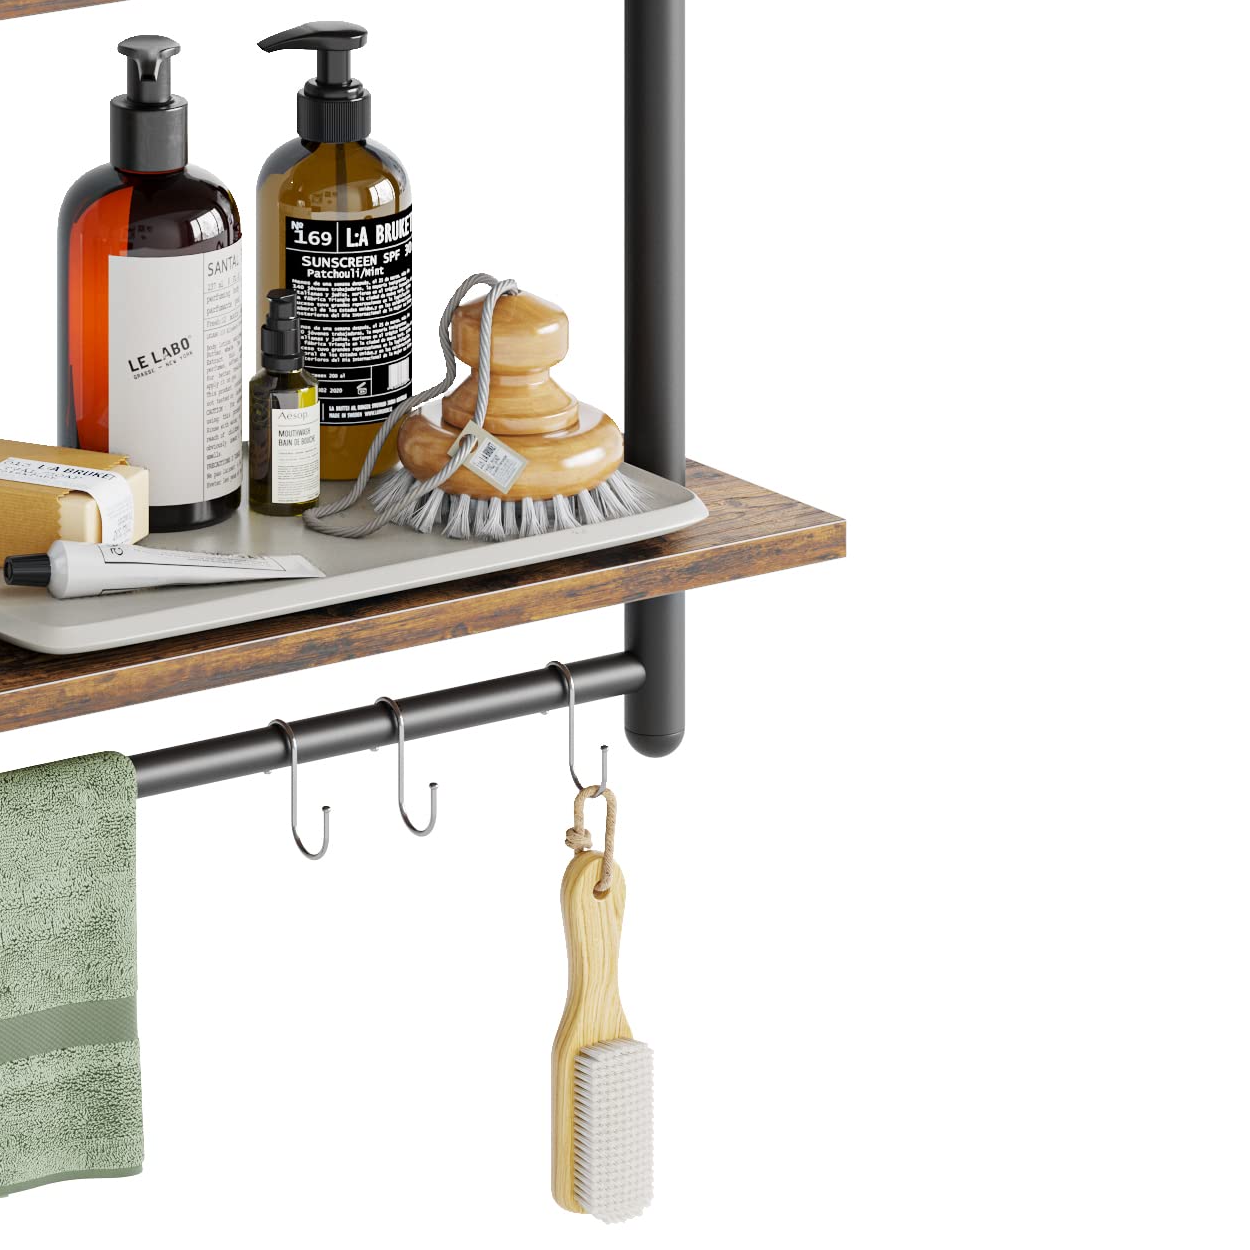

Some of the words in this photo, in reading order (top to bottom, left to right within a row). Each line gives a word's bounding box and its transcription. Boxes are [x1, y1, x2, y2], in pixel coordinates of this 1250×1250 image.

[293, 230, 332, 246] 169
[301, 255, 378, 268] SUNSCREEN
[382, 248, 400, 264] SPF
[306, 266, 384, 279] Patchouli/Mint
[128, 355, 149, 372] LE
[151, 338, 190, 364] LABO
